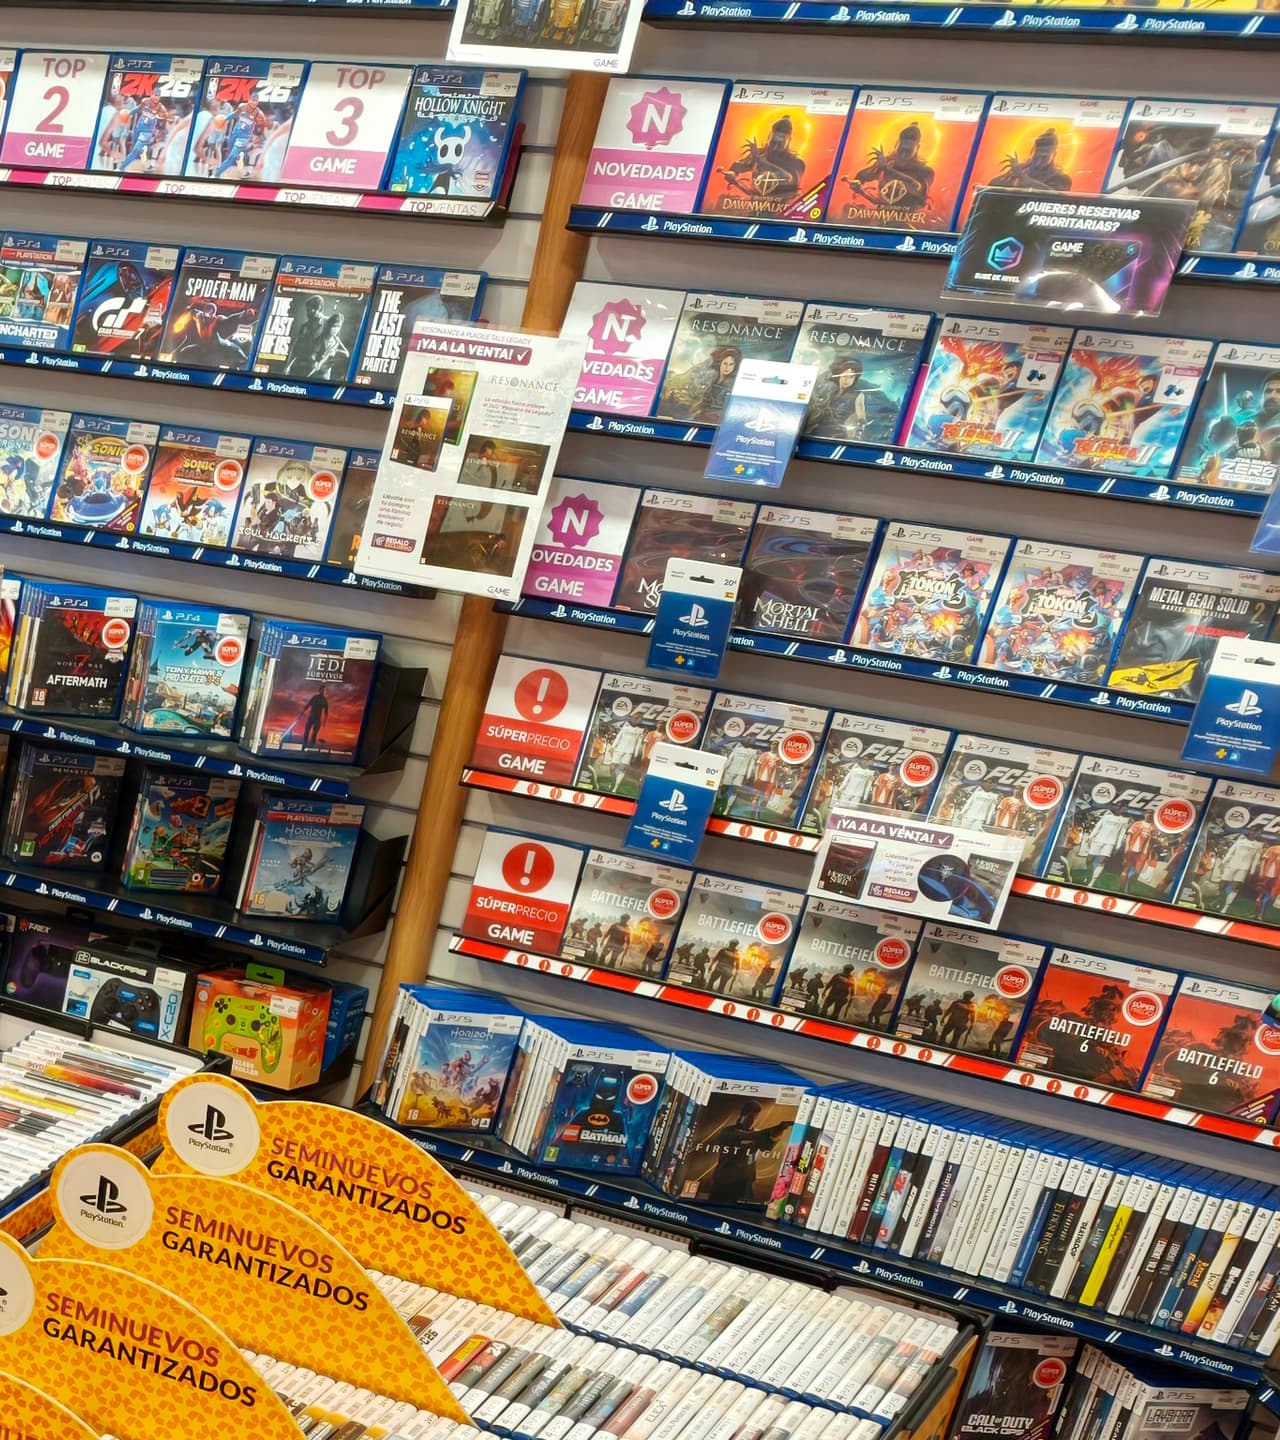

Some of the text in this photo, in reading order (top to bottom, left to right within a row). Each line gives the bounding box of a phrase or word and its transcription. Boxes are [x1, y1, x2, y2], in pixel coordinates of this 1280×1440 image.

[594, 58, 619, 68] GAME
[336, 67, 385, 89] TOP
[415, 96, 506, 116] HOLLOW KNIGHT
[325, 96, 364, 147] 3
[310, 157, 356, 174] GAME
[593, 160, 695, 182] NOVEDADES
[609, 191, 665, 211] GAME
[1019, 201, 1141, 220] ¿QUIERES RESERVAS
[663, 220, 713, 236] PlayStation
[1029, 215, 1120, 231] PRIORITARIAS?
[185, 277, 256, 302] SPIDER-MAN
[417, 338, 513, 361] ¡YA A LA VENTA!
[900, 454, 953, 473] PlayStation
[535, 576, 584, 596] GAME
[1149, 587, 1184, 605] METAL
[1187, 592, 1215, 610] GEAR
[1217, 596, 1250, 614] SOLID
[308, 658, 346, 672] JEDI
[46, 675, 108, 689] AFTERMATH
[1216, 717, 1262, 731] PlayStation
[487, 725, 571, 751] SÚPERPRECIO
[498, 754, 546, 775] GAME
[1049, 1016, 1131, 1047] BATTLEFIELD
[1080, 1038, 1089, 1053] 6
[187, 1137, 231, 1156] PlayStation
[581, 1129, 628, 1146] BATMAN
[270, 1135, 433, 1201] SEMINUEVOS
[266, 1159, 467, 1236] GARANTIZADOS
[875, 1266, 924, 1288] PlayStation
[45, 1290, 221, 1369] SEMINUEVOS
[42, 1315, 258, 1408] GARANTIZADOS
